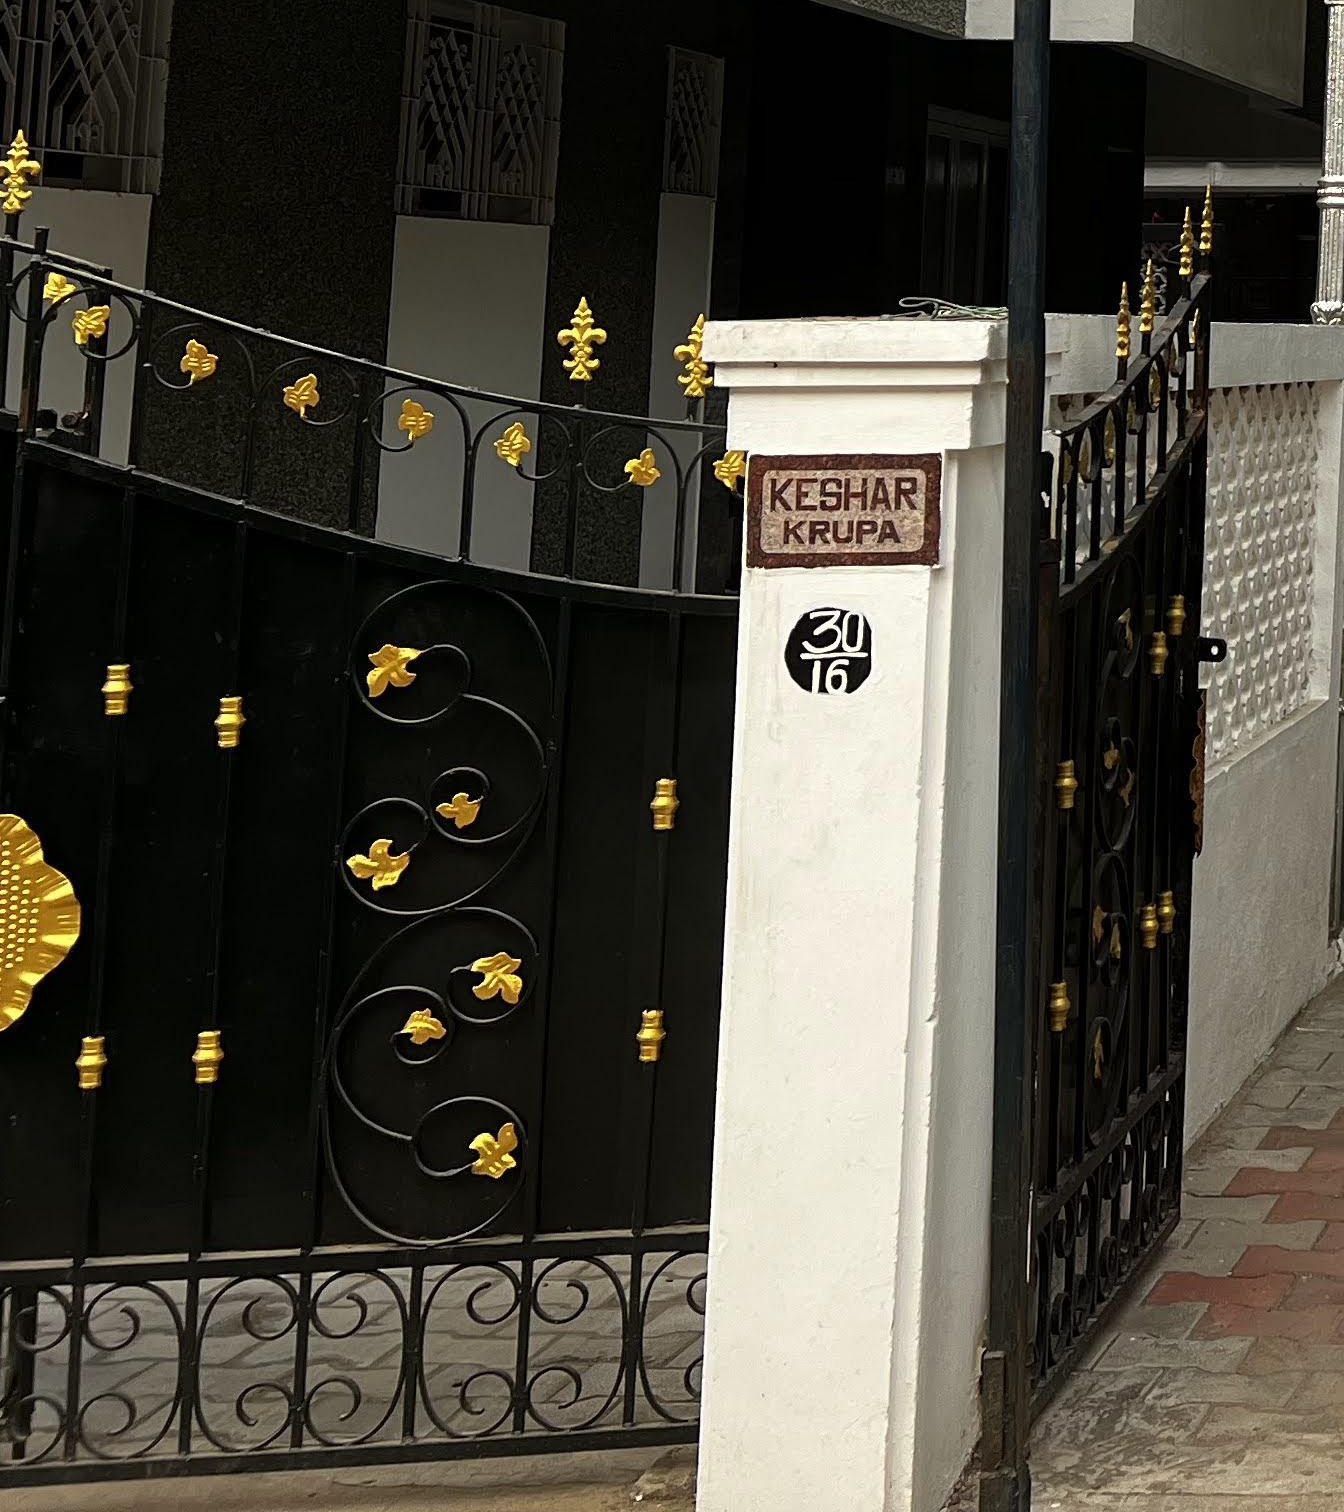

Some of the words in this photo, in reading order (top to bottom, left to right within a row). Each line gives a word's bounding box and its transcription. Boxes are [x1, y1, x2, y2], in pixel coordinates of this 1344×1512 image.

[769, 477, 918, 513] KESHAR
[782, 519, 902, 545] KRUPA
[802, 609, 865, 654] 30
[811, 659, 849, 694] 16
